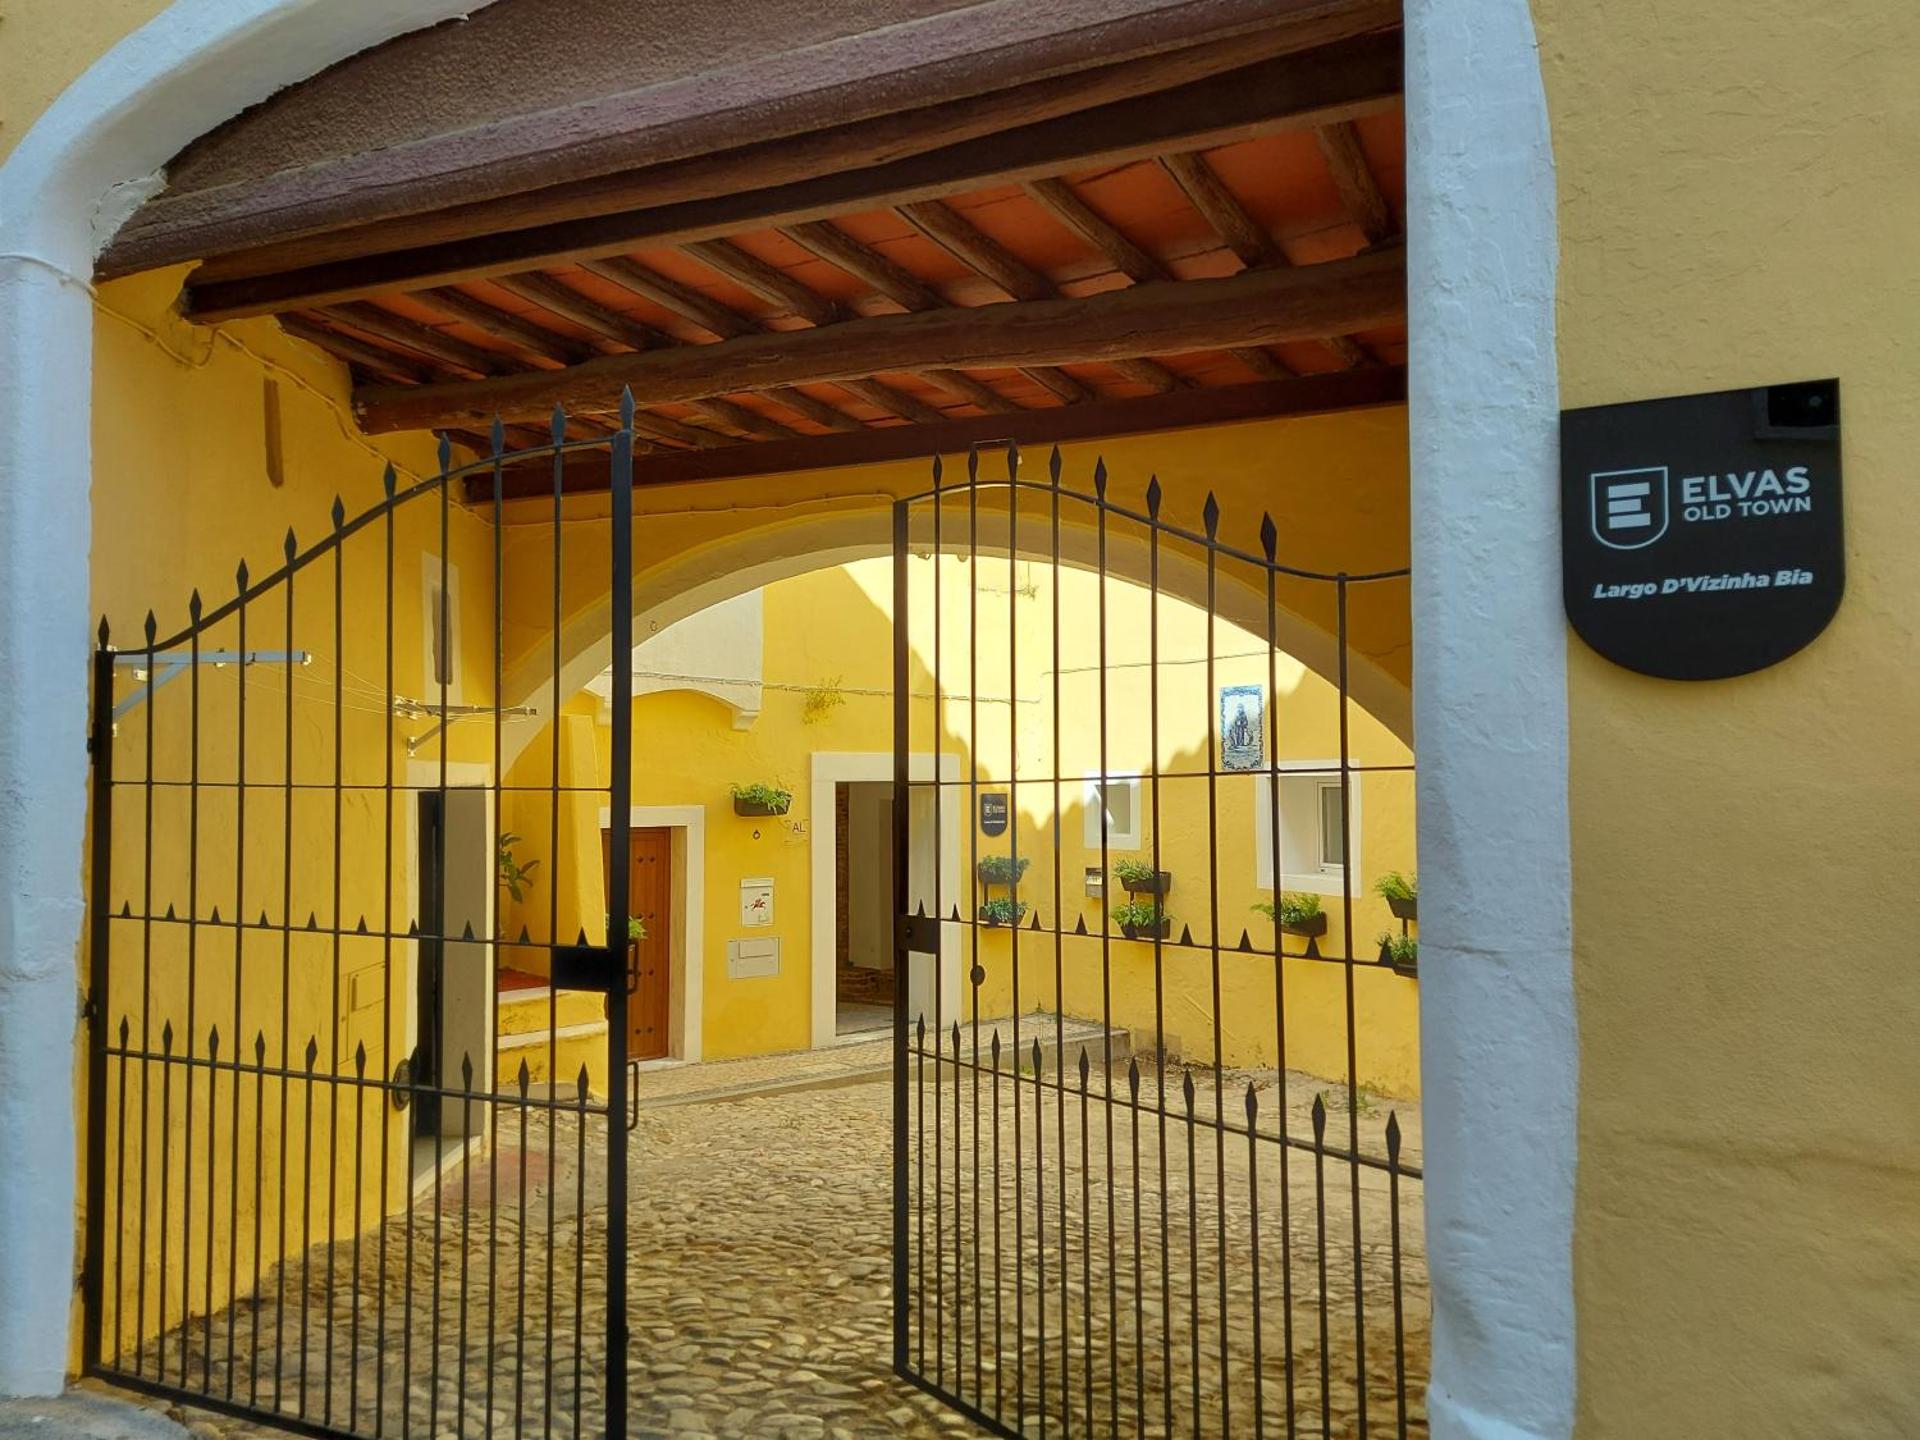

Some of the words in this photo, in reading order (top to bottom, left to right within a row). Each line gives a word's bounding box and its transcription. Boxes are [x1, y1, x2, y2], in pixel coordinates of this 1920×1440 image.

[1682, 466, 1811, 504] ELVAS
[1683, 503, 1732, 522] OLD
[1736, 495, 1812, 517] TOWN
[1593, 582, 1658, 599] Largo
[1773, 568, 1814, 587] Bia
